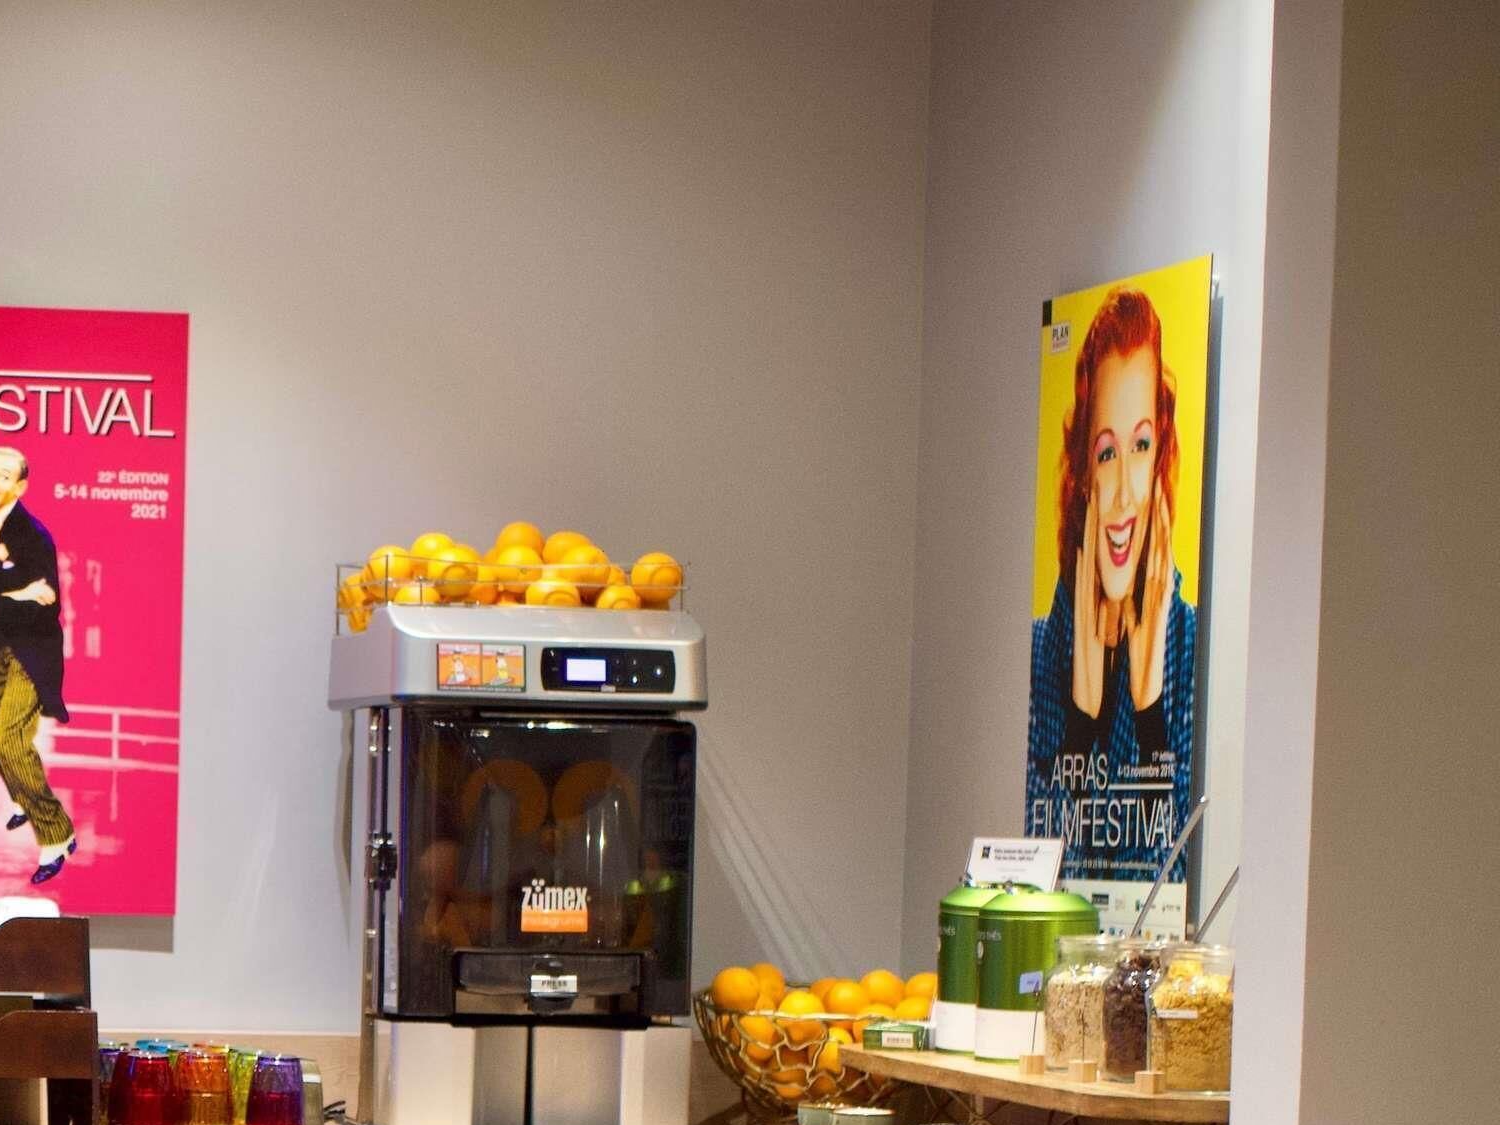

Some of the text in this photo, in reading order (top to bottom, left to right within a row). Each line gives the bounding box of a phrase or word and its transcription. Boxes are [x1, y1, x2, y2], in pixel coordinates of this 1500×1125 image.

[118, 469, 170, 486] ÉDITION
[54, 483, 169, 502] 5-14 novembre
[131, 503, 167, 519] 2021
[1050, 753, 1109, 792] ARRAS
